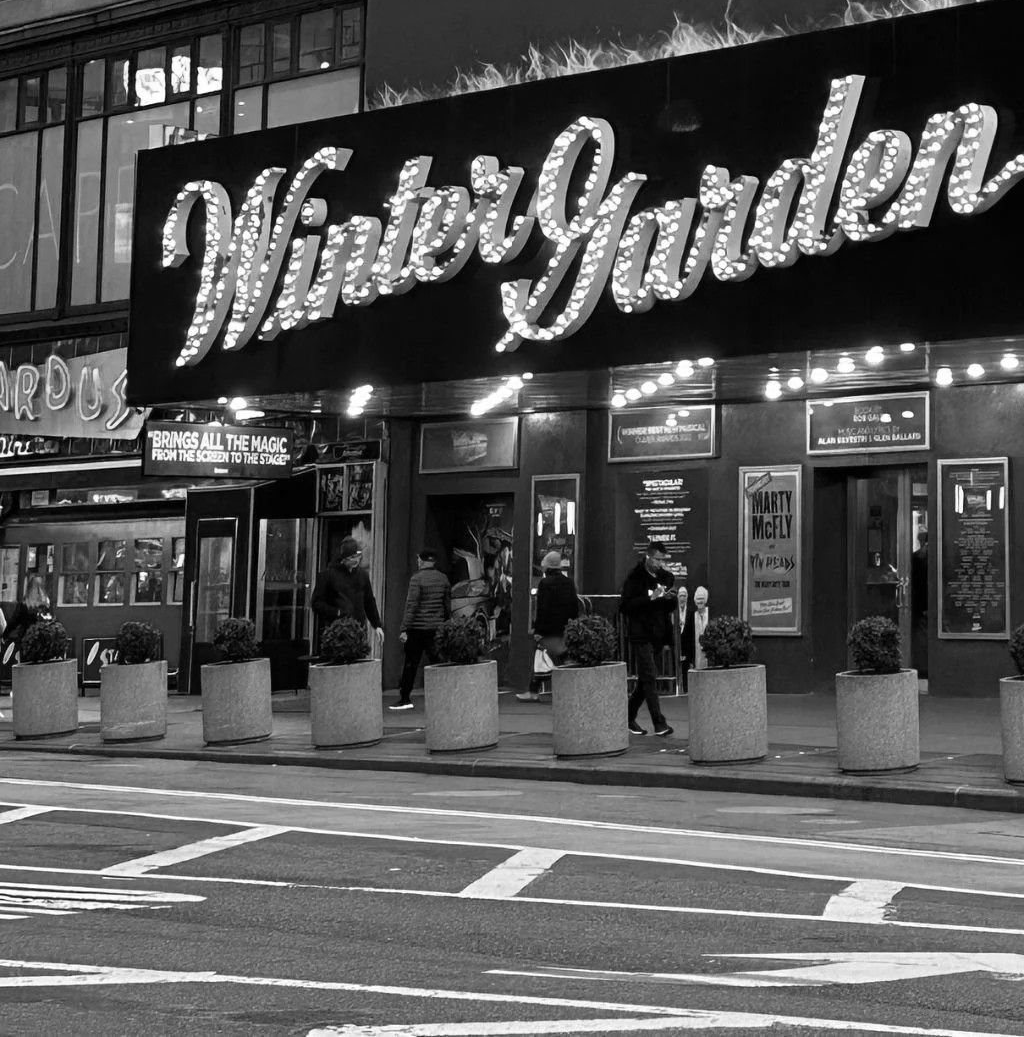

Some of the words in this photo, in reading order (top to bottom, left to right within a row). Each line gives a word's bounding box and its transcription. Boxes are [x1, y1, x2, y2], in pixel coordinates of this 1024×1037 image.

[159, 146, 536, 367] Winter
[200, 432, 224, 450] ALL
[226, 433, 250, 451] THE
[251, 435, 288, 453] MAGIC
[152, 448, 177, 461] FROM
[178, 449, 196, 462] THE
[230, 452, 242, 463] TO
[243, 452, 259, 464] THE
[752, 490, 792, 514] MARTY
[752, 514, 792, 540] McFLY
